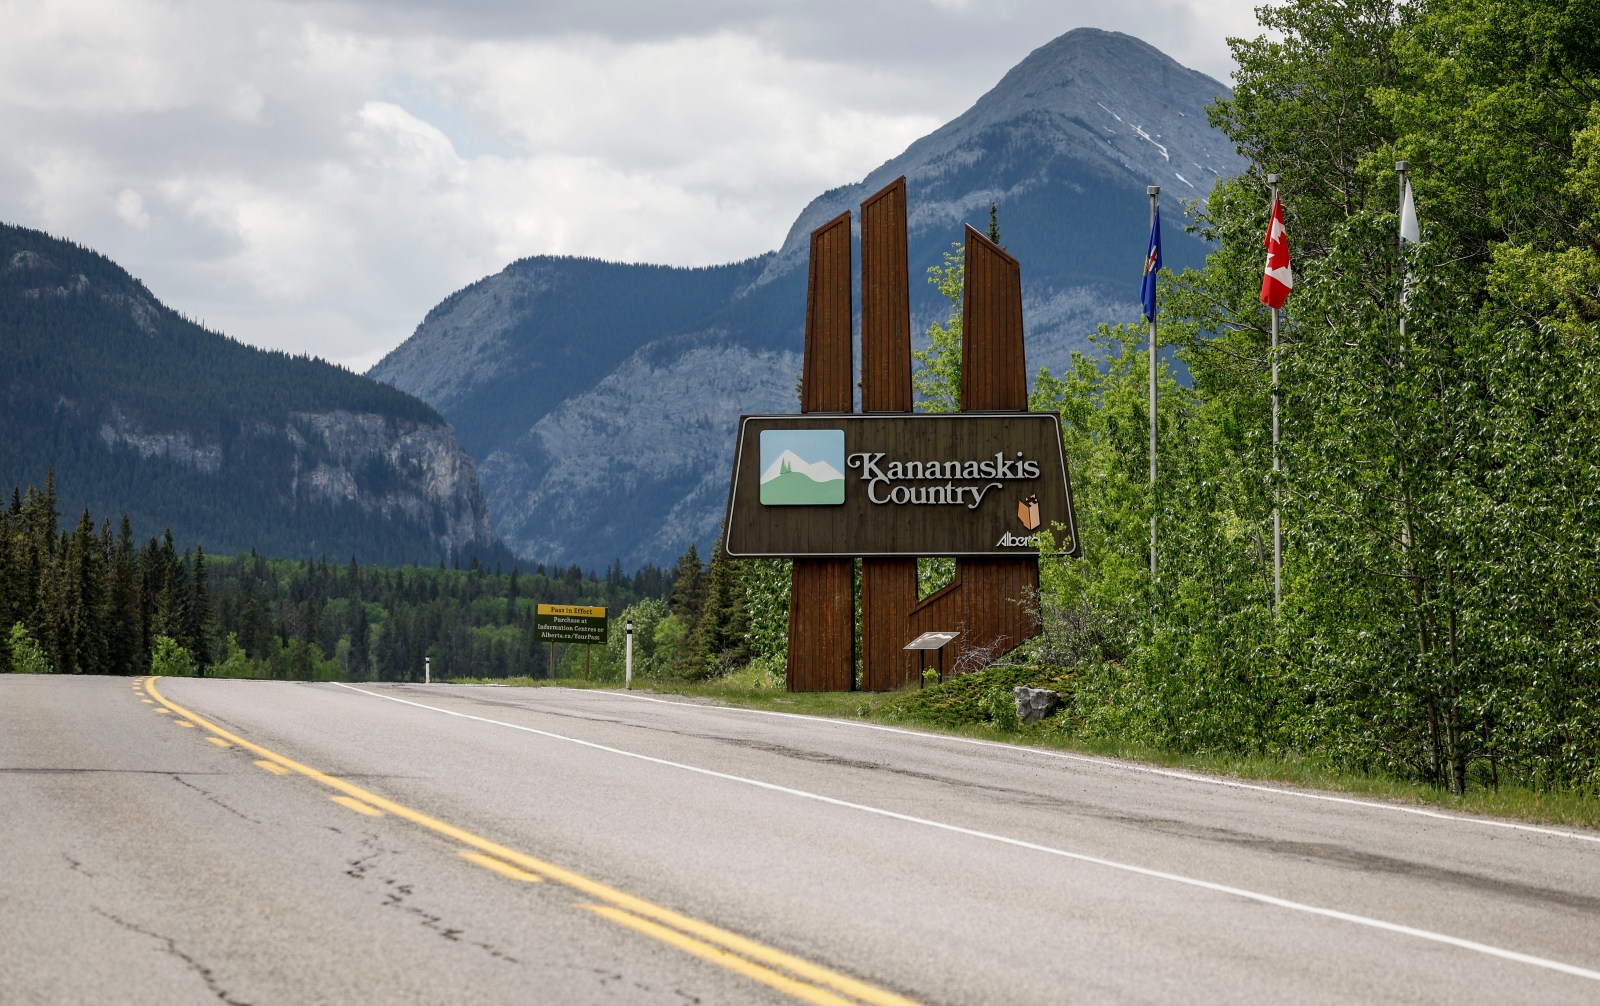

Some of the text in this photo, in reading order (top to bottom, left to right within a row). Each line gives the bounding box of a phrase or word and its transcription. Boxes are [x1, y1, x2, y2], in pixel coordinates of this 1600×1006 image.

[847, 452, 1040, 484] Kananaskis
[868, 476, 1003, 508] Country
[996, 531, 1040, 546] Albera
[541, 632, 600, 640] Alberta.ca/YourPass
